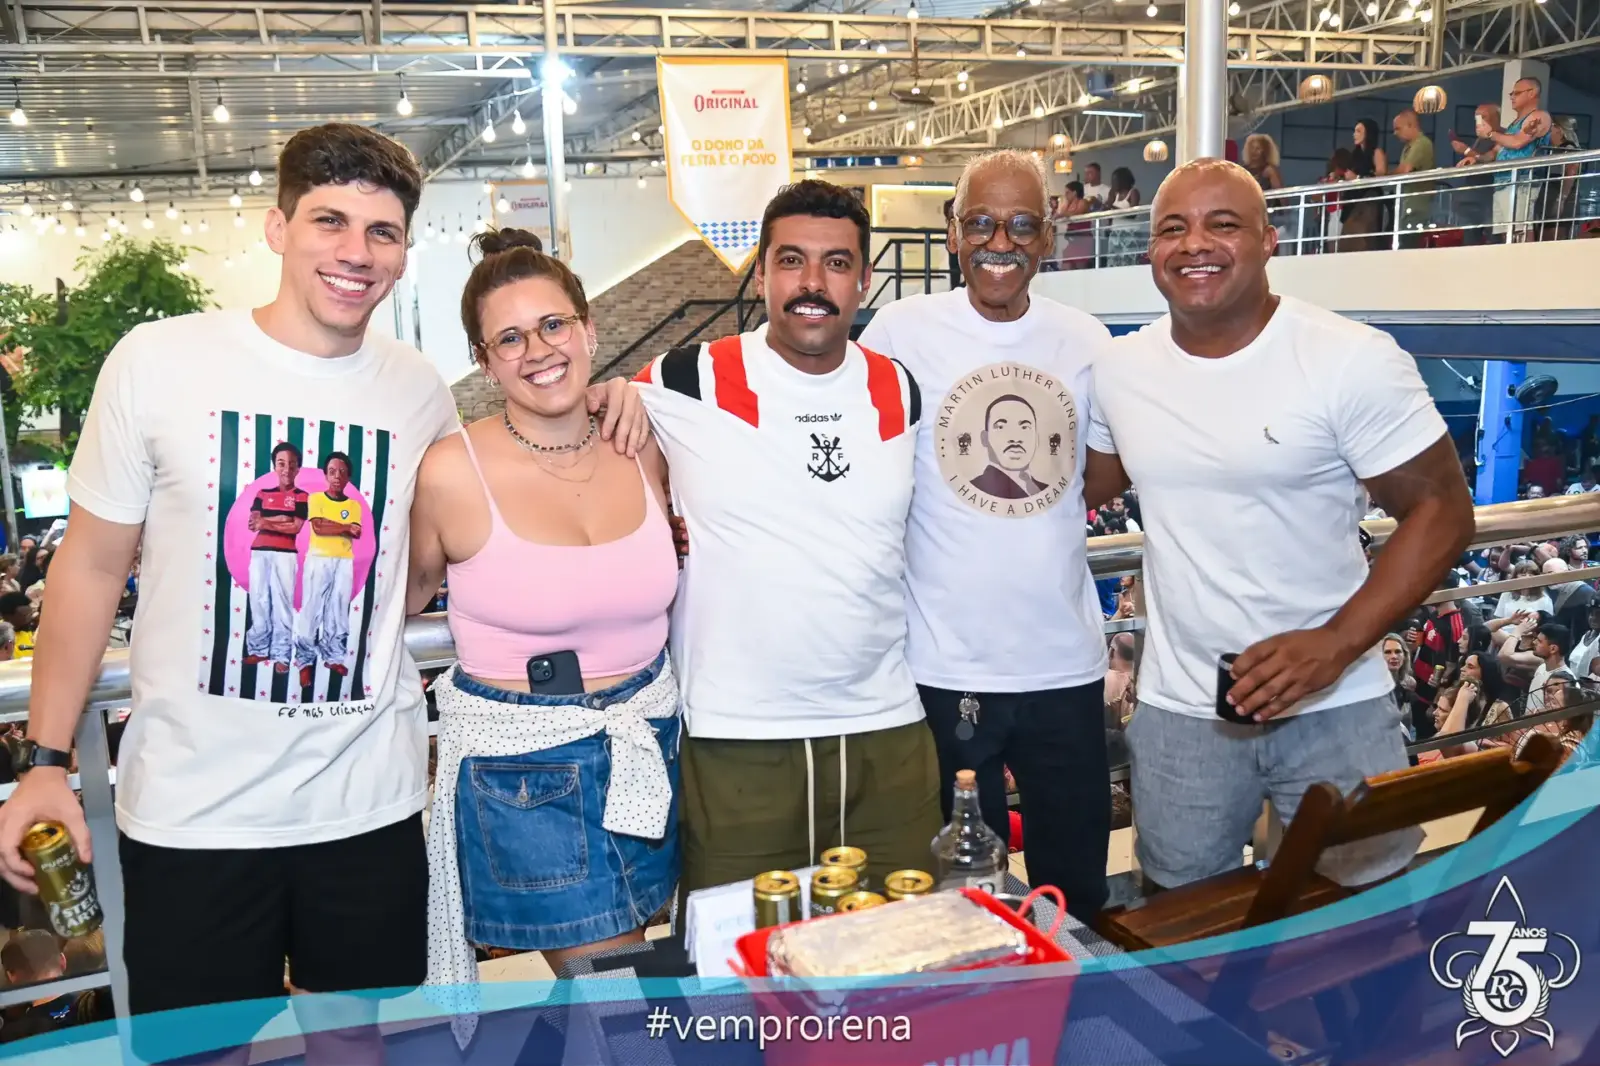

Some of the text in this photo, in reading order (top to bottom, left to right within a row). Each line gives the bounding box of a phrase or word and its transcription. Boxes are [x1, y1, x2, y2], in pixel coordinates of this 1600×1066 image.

[694, 95, 759, 112] ORIGINAL
[692, 138, 764, 151] O DONO DA
[681, 154, 717, 166] FESTA
[729, 154, 740, 165] O
[743, 153, 776, 166] POVO
[939, 366, 1076, 430] MARTIN LUTHER KING
[795, 414, 829, 422] adidas
[949, 474, 1068, 514] I HAVE A DREAM
[303, 706, 323, 718] nas
